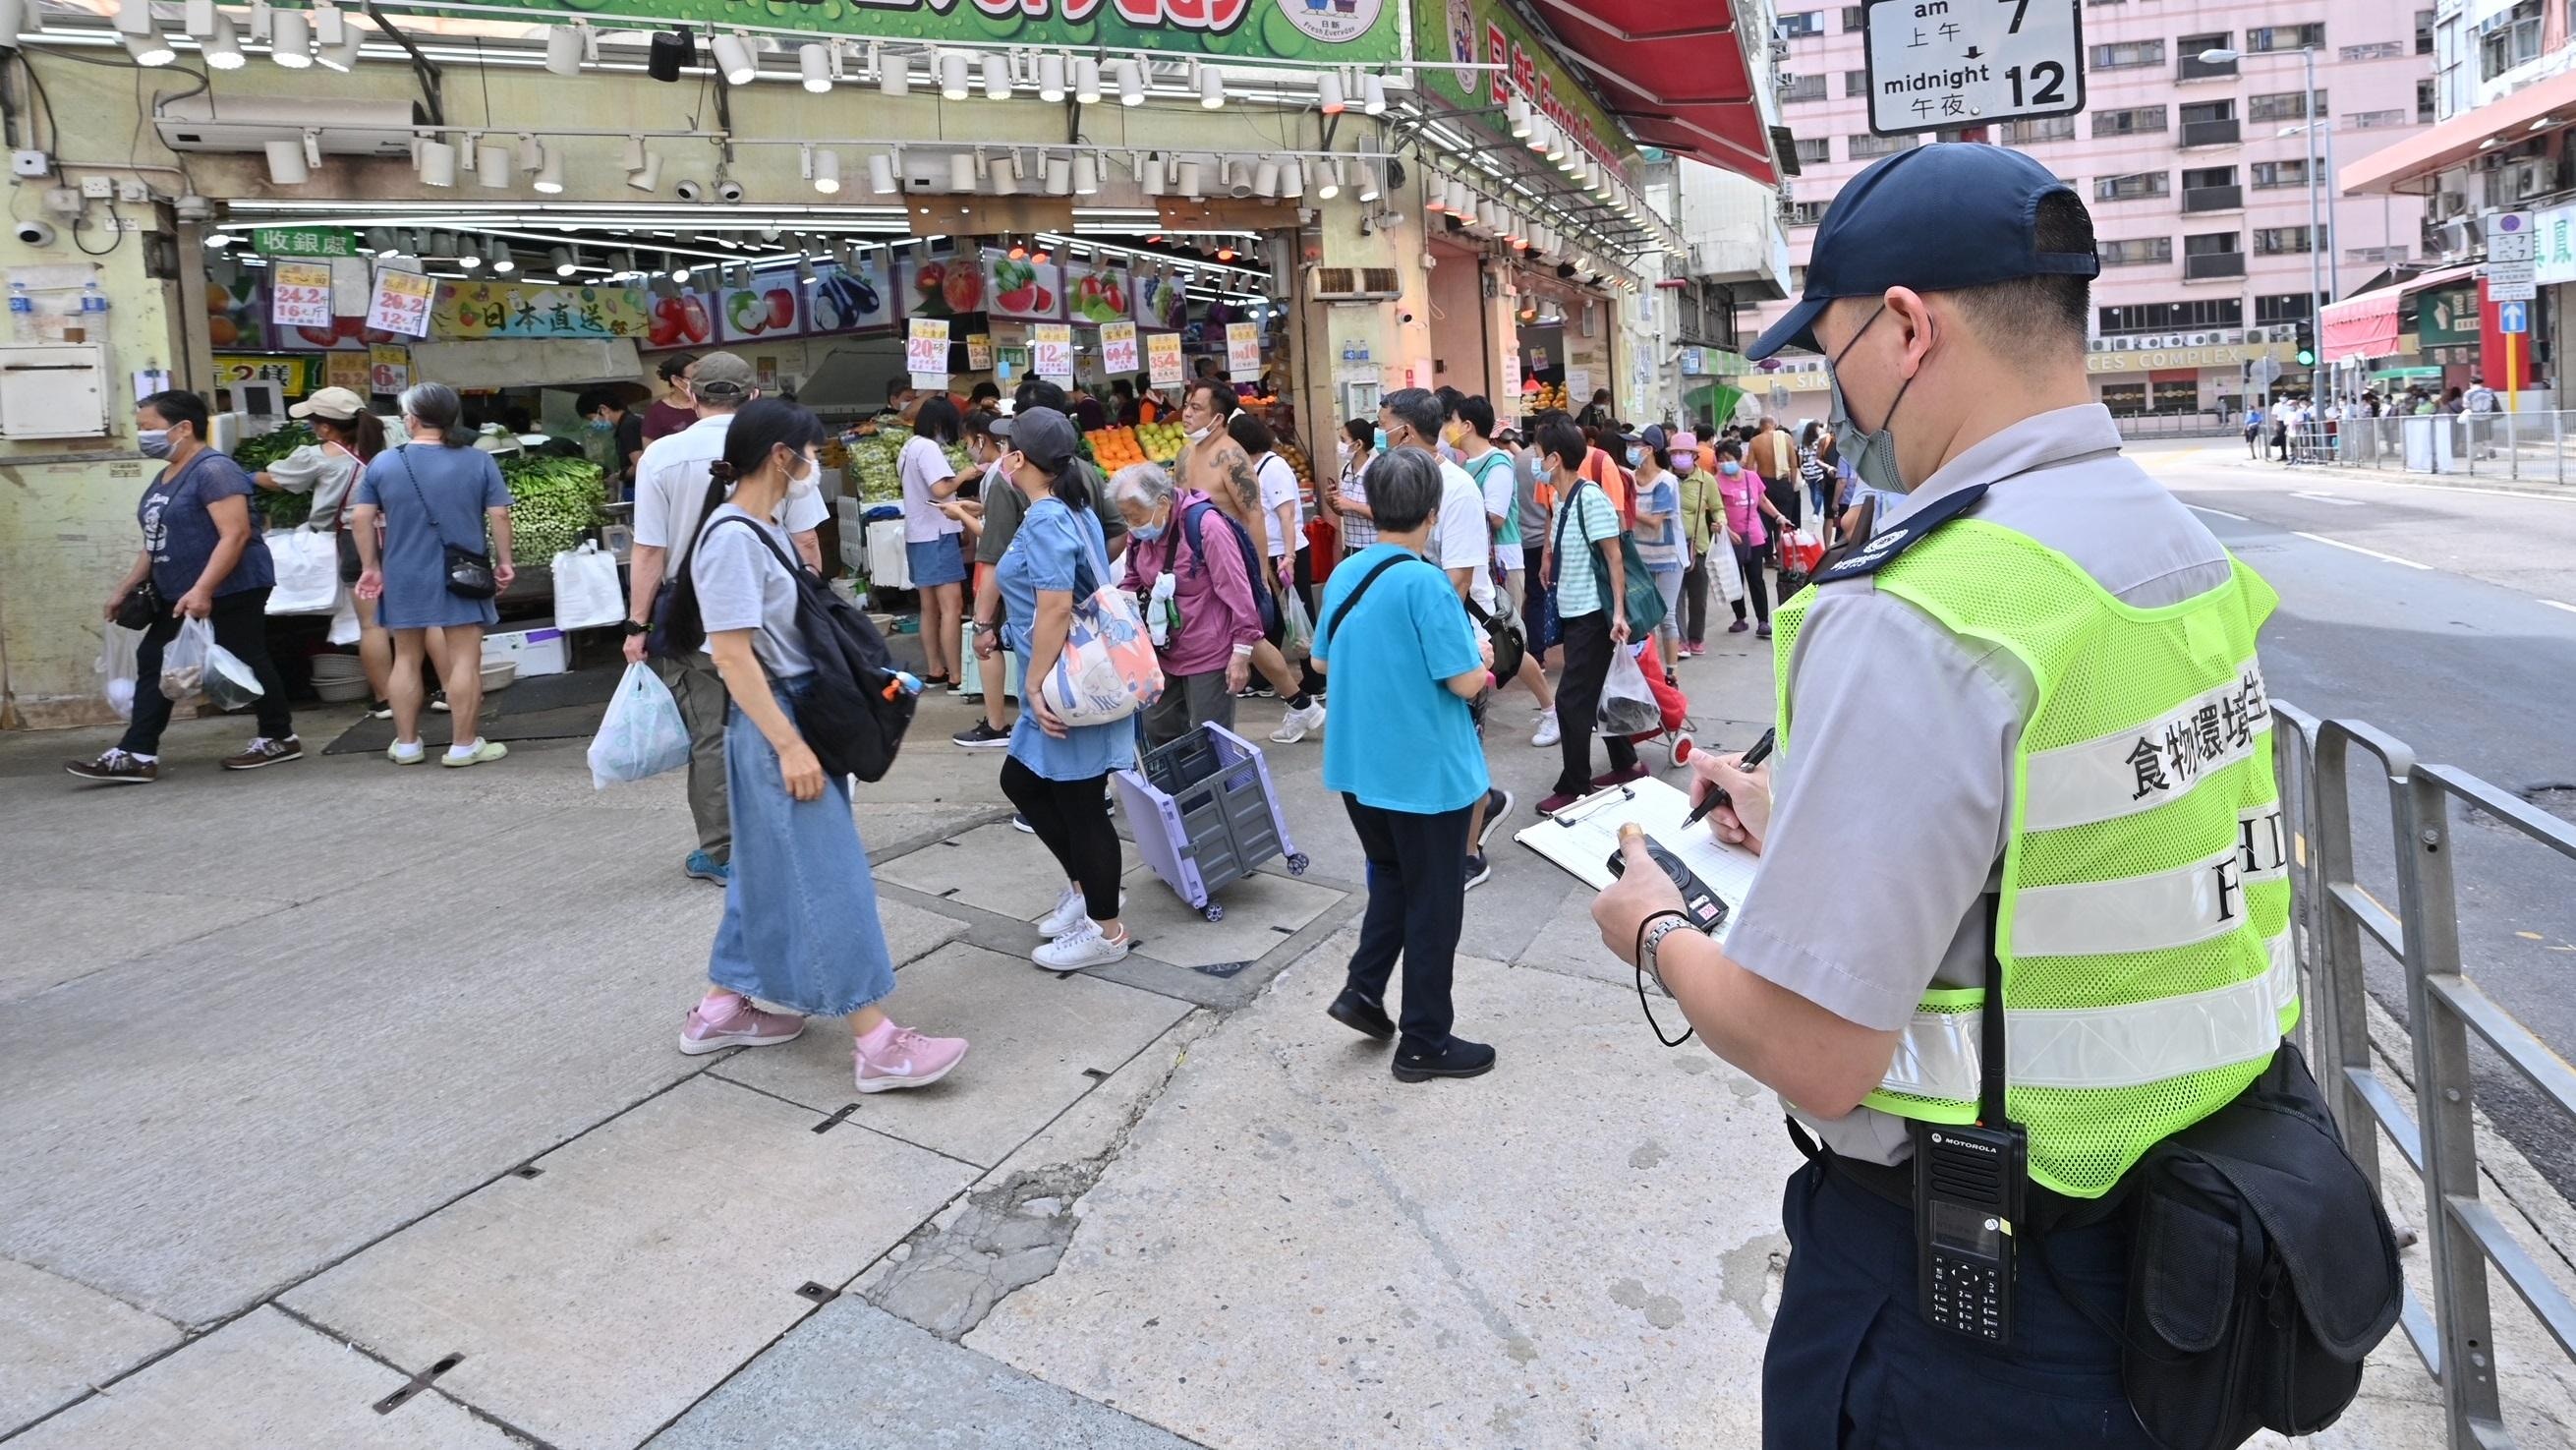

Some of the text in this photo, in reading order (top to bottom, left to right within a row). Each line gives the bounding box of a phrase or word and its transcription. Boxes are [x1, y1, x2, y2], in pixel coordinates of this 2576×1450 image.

[1303, 22, 1324, 35] Fresh
[1915, 0, 2029, 34] am 7
[1907, 22, 1961, 48] 上午
[1884, 60, 2065, 108] midnight 12
[1911, 93, 1965, 120] 午夜
[262, 230, 347, 255] 收銀處
[2517, 236, 2525, 245] 7
[2517, 250, 2525, 259] 7
[482, 300, 605, 332] 日本直送
[1038, 345, 1058, 362] 12
[2139, 347, 2240, 368] COMPLEX
[1945, 1137, 1997, 1154] MOTOROLA
